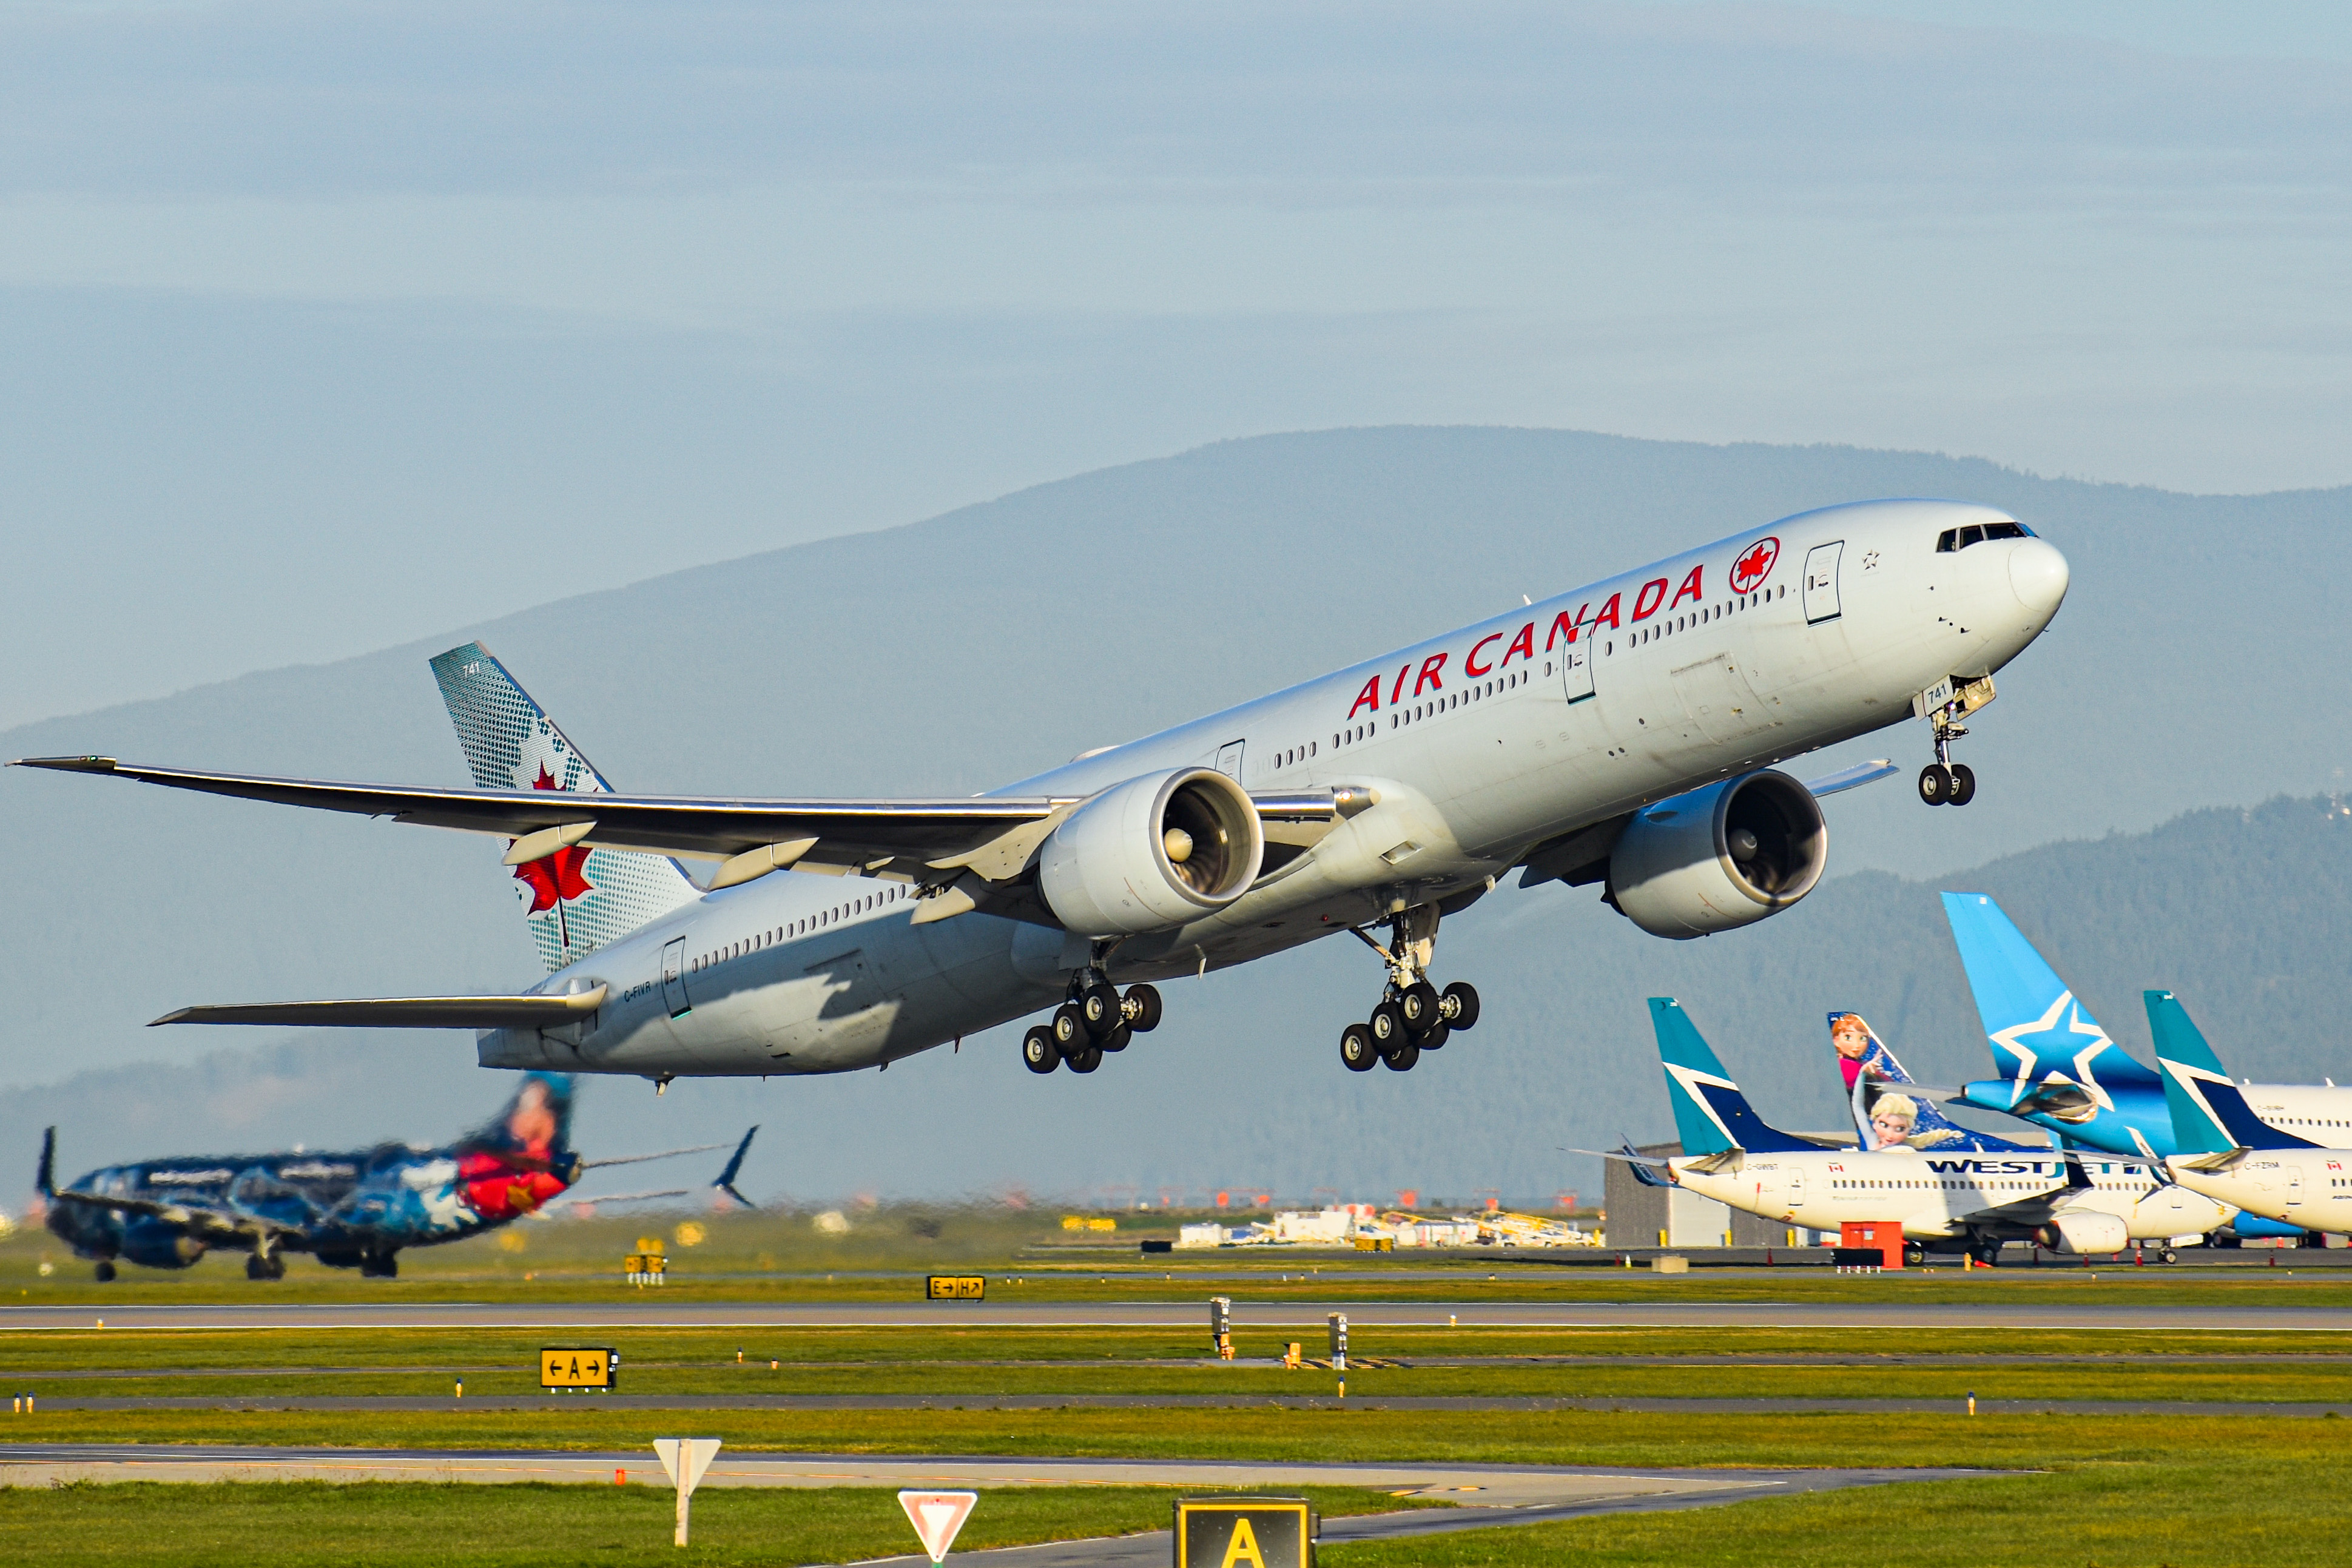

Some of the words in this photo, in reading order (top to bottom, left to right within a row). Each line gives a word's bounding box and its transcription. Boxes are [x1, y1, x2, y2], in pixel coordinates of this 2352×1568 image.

[1347, 651, 1448, 721] AIR
[1464, 564, 1704, 678] CANADA
[462, 661, 480, 678] 741
[1928, 683, 1946, 704] 741
[624, 980, 651, 1003] C-FIVR
[934, 1280, 941, 1294] E
[960, 1280, 969, 1295] H
[568, 1356, 581, 1379] A
[1221, 1518, 1267, 1568] A
